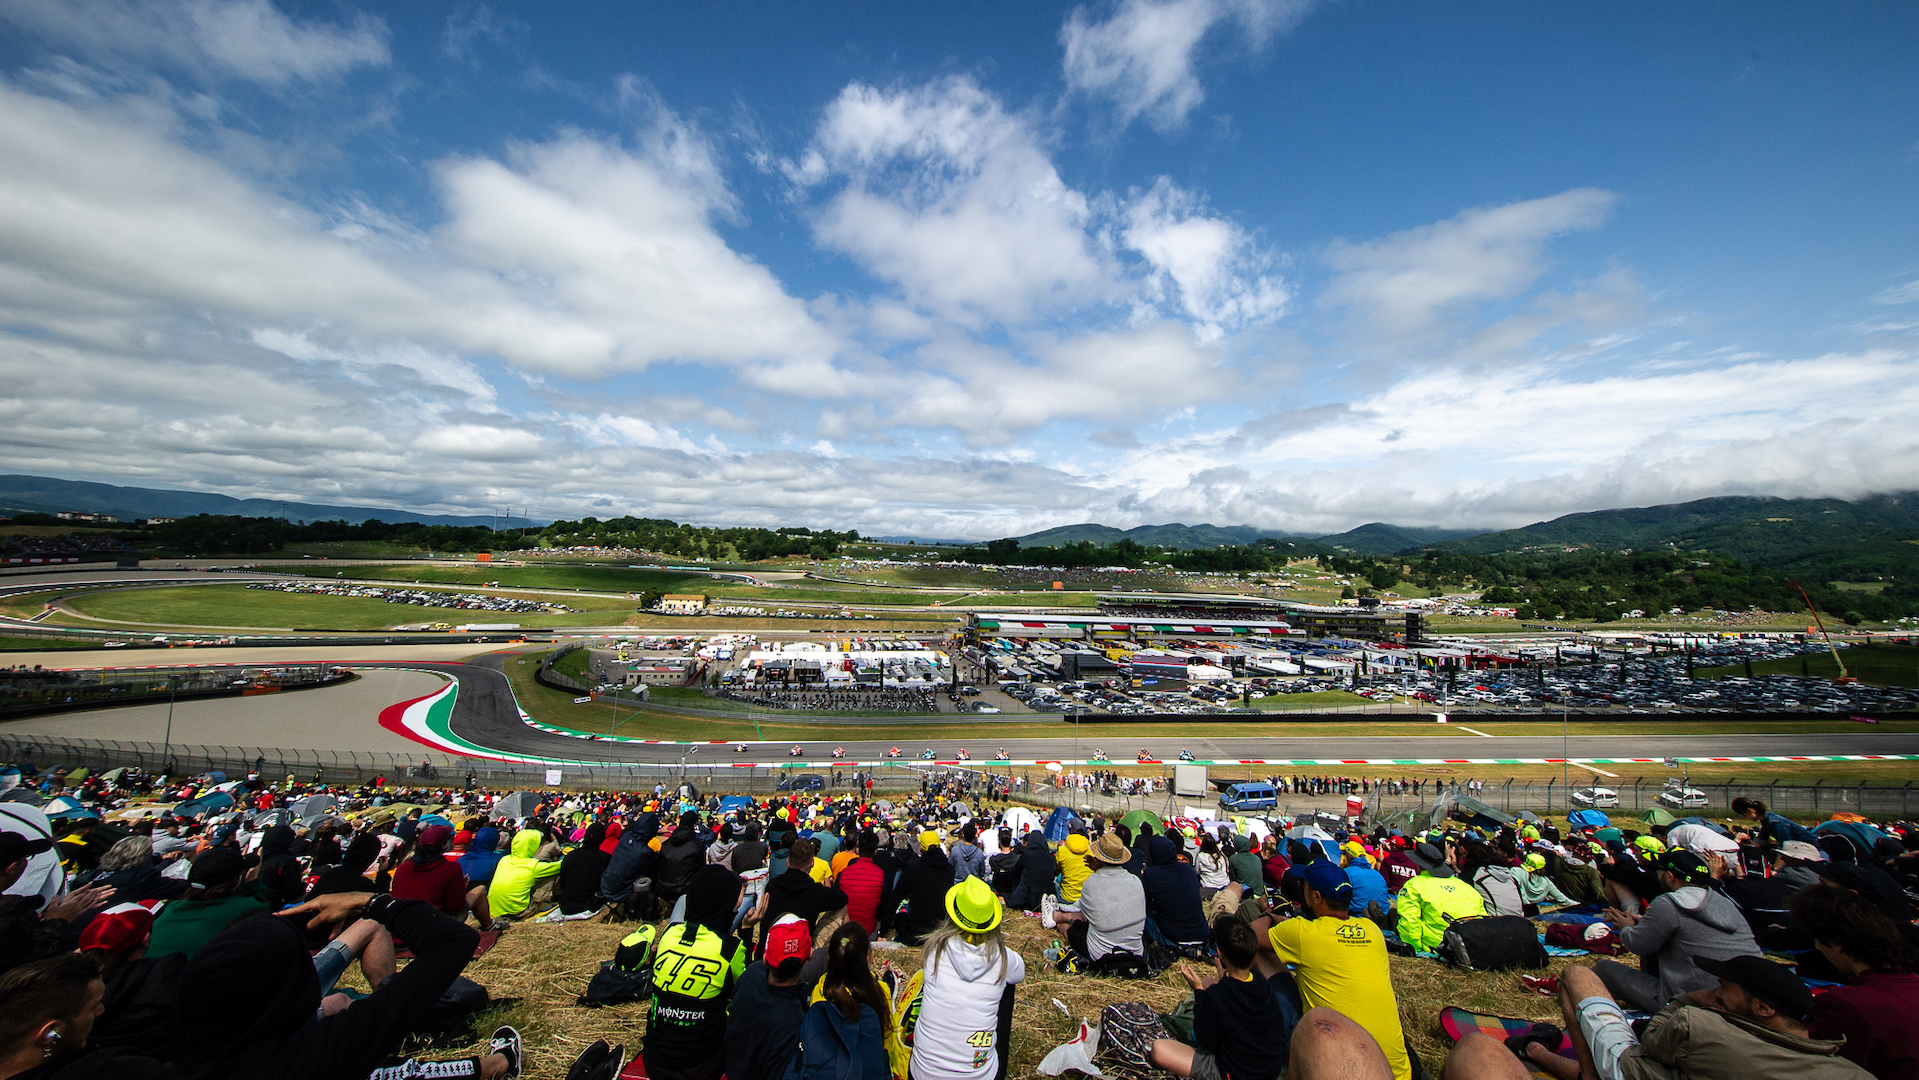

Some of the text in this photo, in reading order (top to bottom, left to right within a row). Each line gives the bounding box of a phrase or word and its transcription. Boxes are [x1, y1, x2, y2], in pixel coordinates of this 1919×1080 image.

[1336, 924, 1365, 939] 46
[784, 938, 799, 954] 58
[652, 949, 722, 999] 46
[657, 1006, 705, 1020] MONSTER
[966, 1030, 994, 1048] 46
